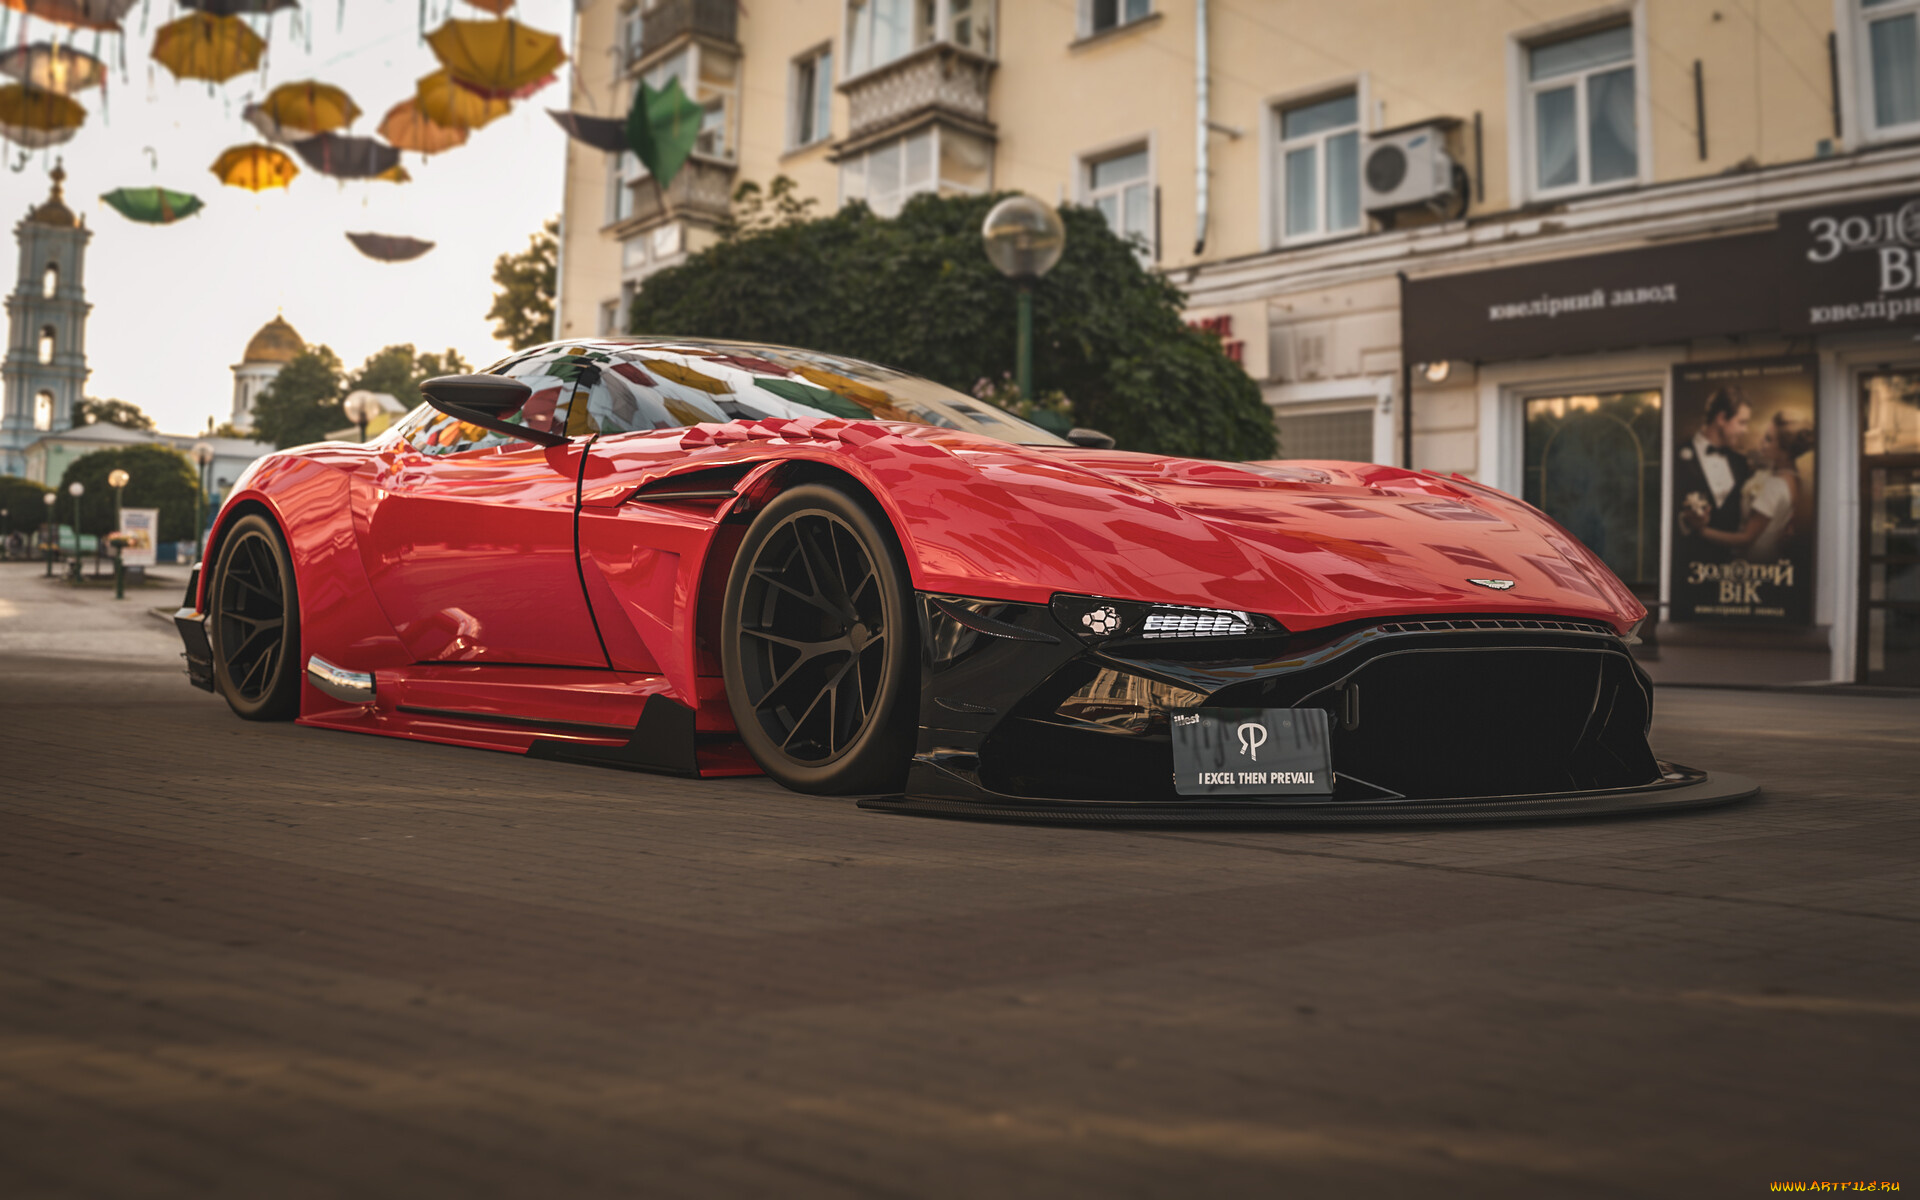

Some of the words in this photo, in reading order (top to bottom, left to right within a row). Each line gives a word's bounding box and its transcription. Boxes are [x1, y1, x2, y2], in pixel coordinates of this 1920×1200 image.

[1489, 288, 1605, 320] ювелірний
[1611, 284, 1676, 306] завод
[1204, 772, 1236, 785] EXCEL
[1238, 772, 1267, 785] THEN
[1270, 772, 1315, 785] PREVAIL
